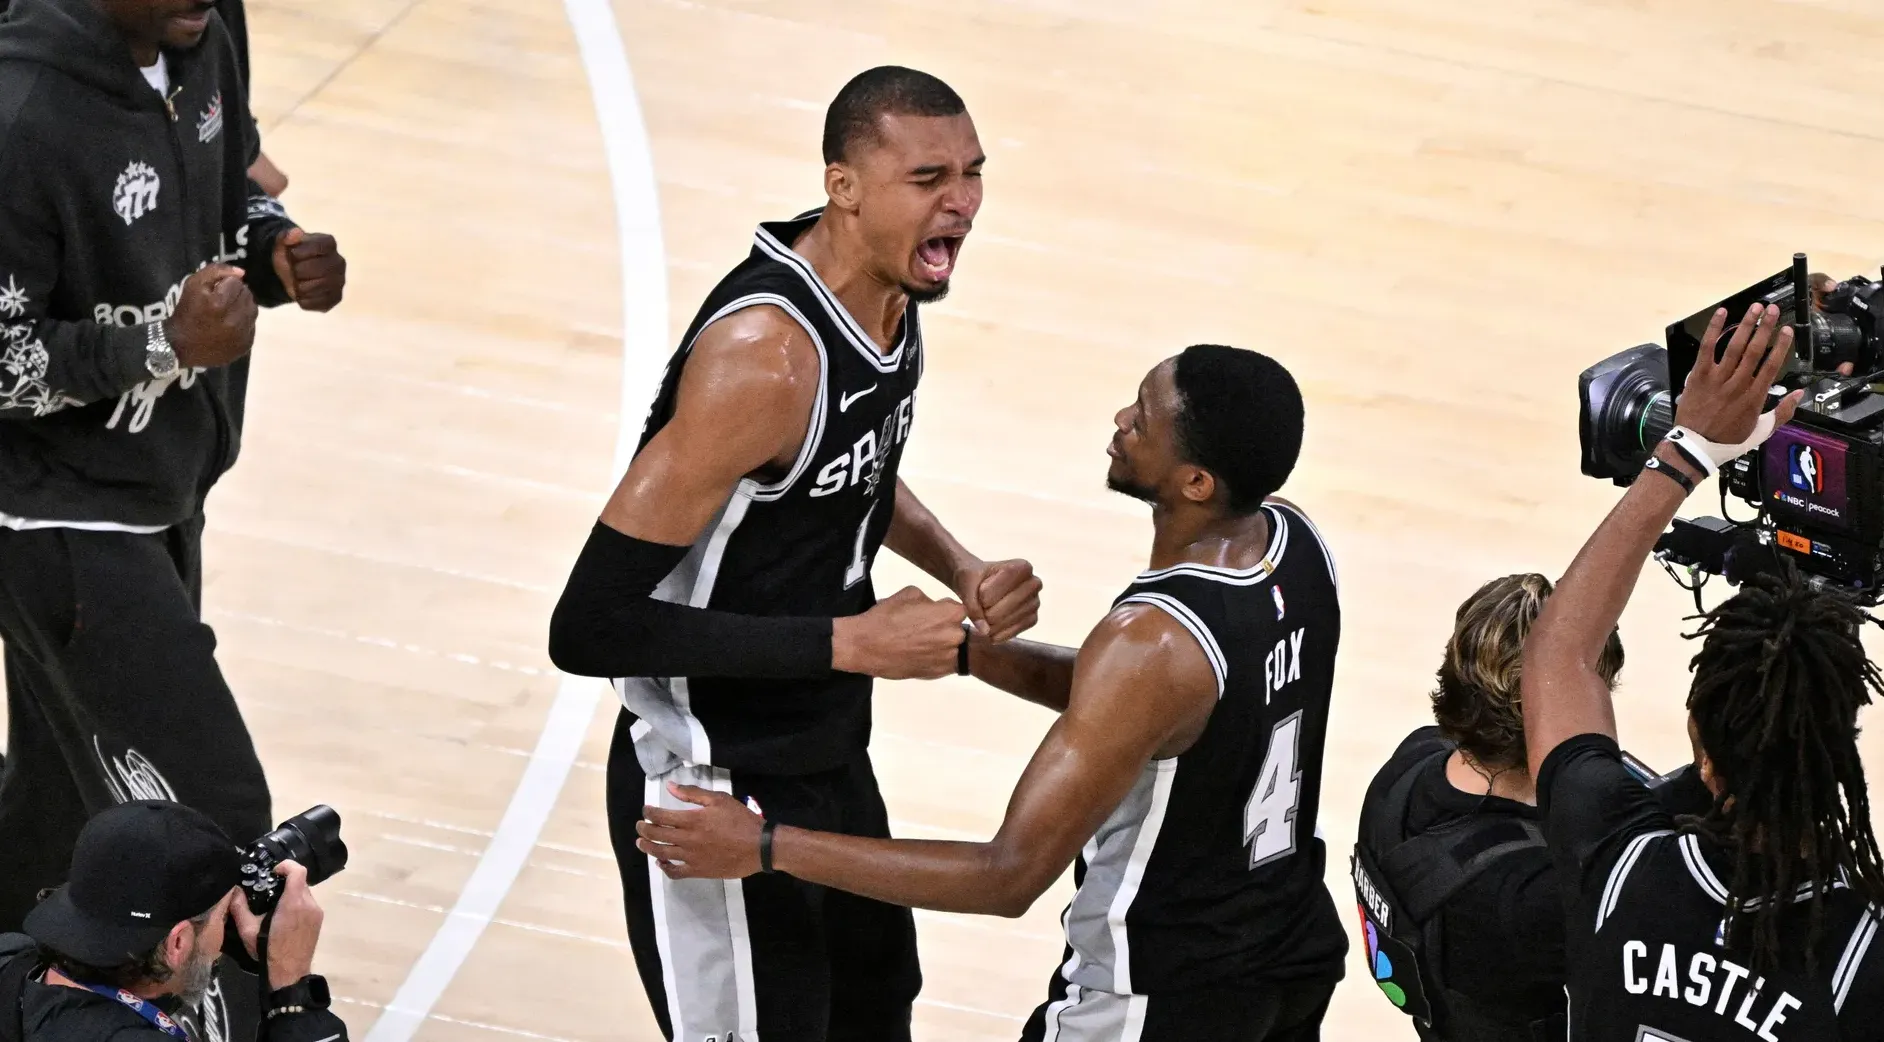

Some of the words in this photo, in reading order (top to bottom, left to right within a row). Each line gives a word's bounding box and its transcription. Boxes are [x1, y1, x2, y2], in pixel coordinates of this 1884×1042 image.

[809, 387, 918, 498] SPUR
[843, 498, 879, 591] 1
[1787, 495, 1805, 508] NBC
[1808, 502, 1840, 518] peacock
[1264, 627, 1305, 706] FOX
[1243, 708, 1303, 871] 4
[1623, 940, 1802, 1042] CASTLE
